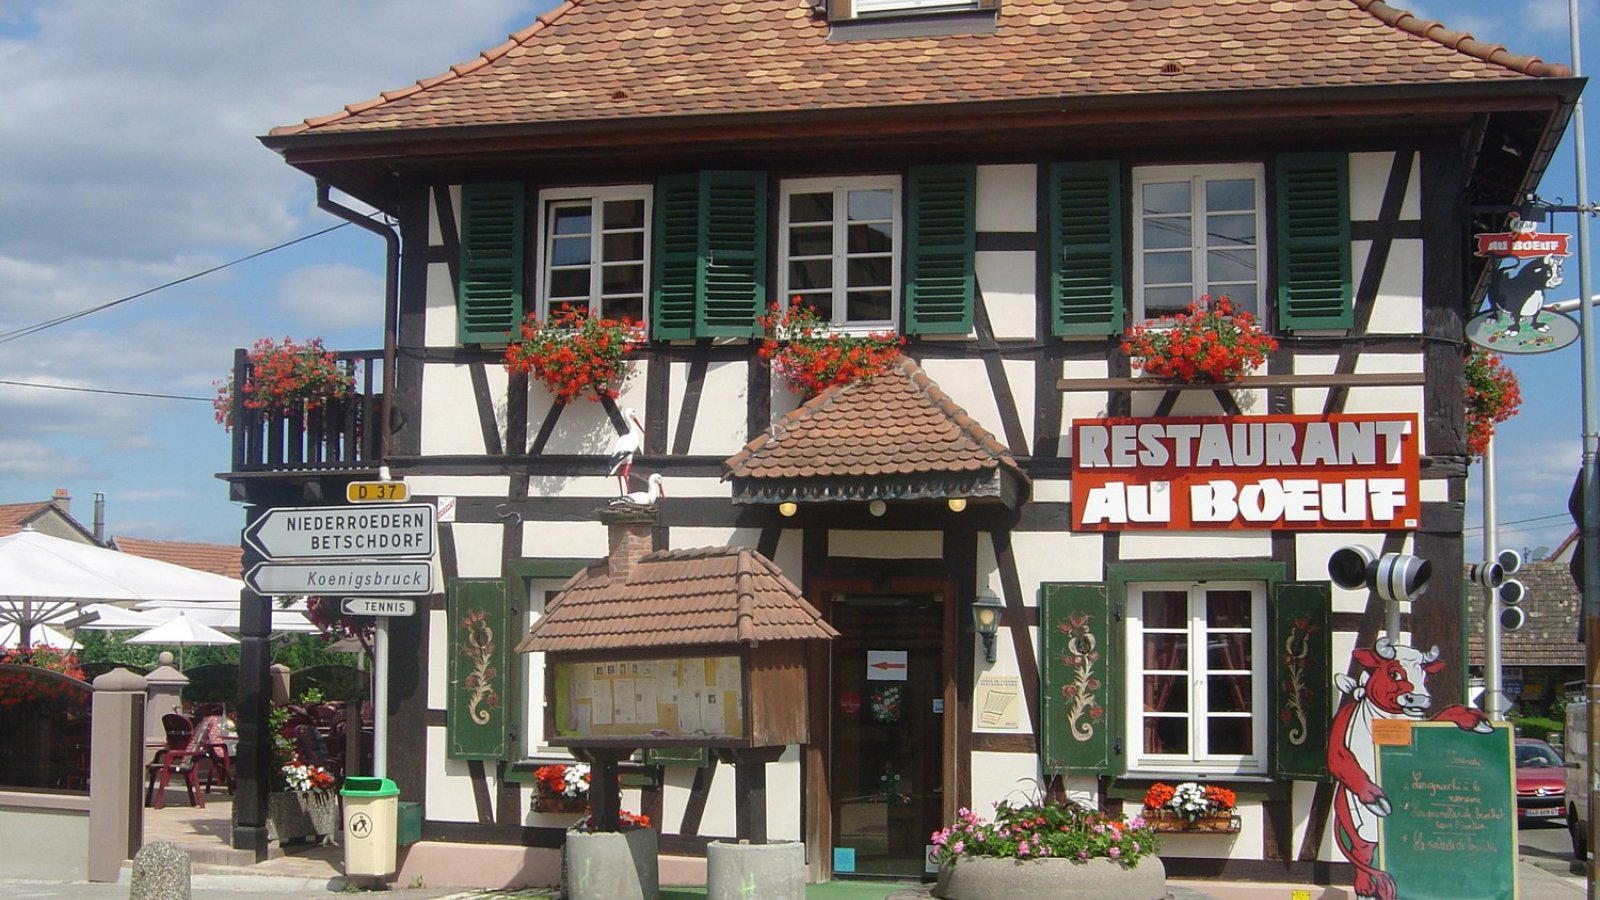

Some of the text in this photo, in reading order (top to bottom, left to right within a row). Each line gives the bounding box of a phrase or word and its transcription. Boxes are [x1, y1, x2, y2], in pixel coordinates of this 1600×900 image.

[1488, 240, 1507, 250] AU
[1079, 420, 1411, 468] RESTAURANT
[358, 485, 397, 499] D 37
[1081, 480, 1171, 524] AU
[287, 513, 424, 531] NIEDERROEDERN
[312, 533, 424, 549] BETSCHDORF
[307, 571, 421, 589] Koenigsbruck
[364, 601, 405, 612] TENNIS
